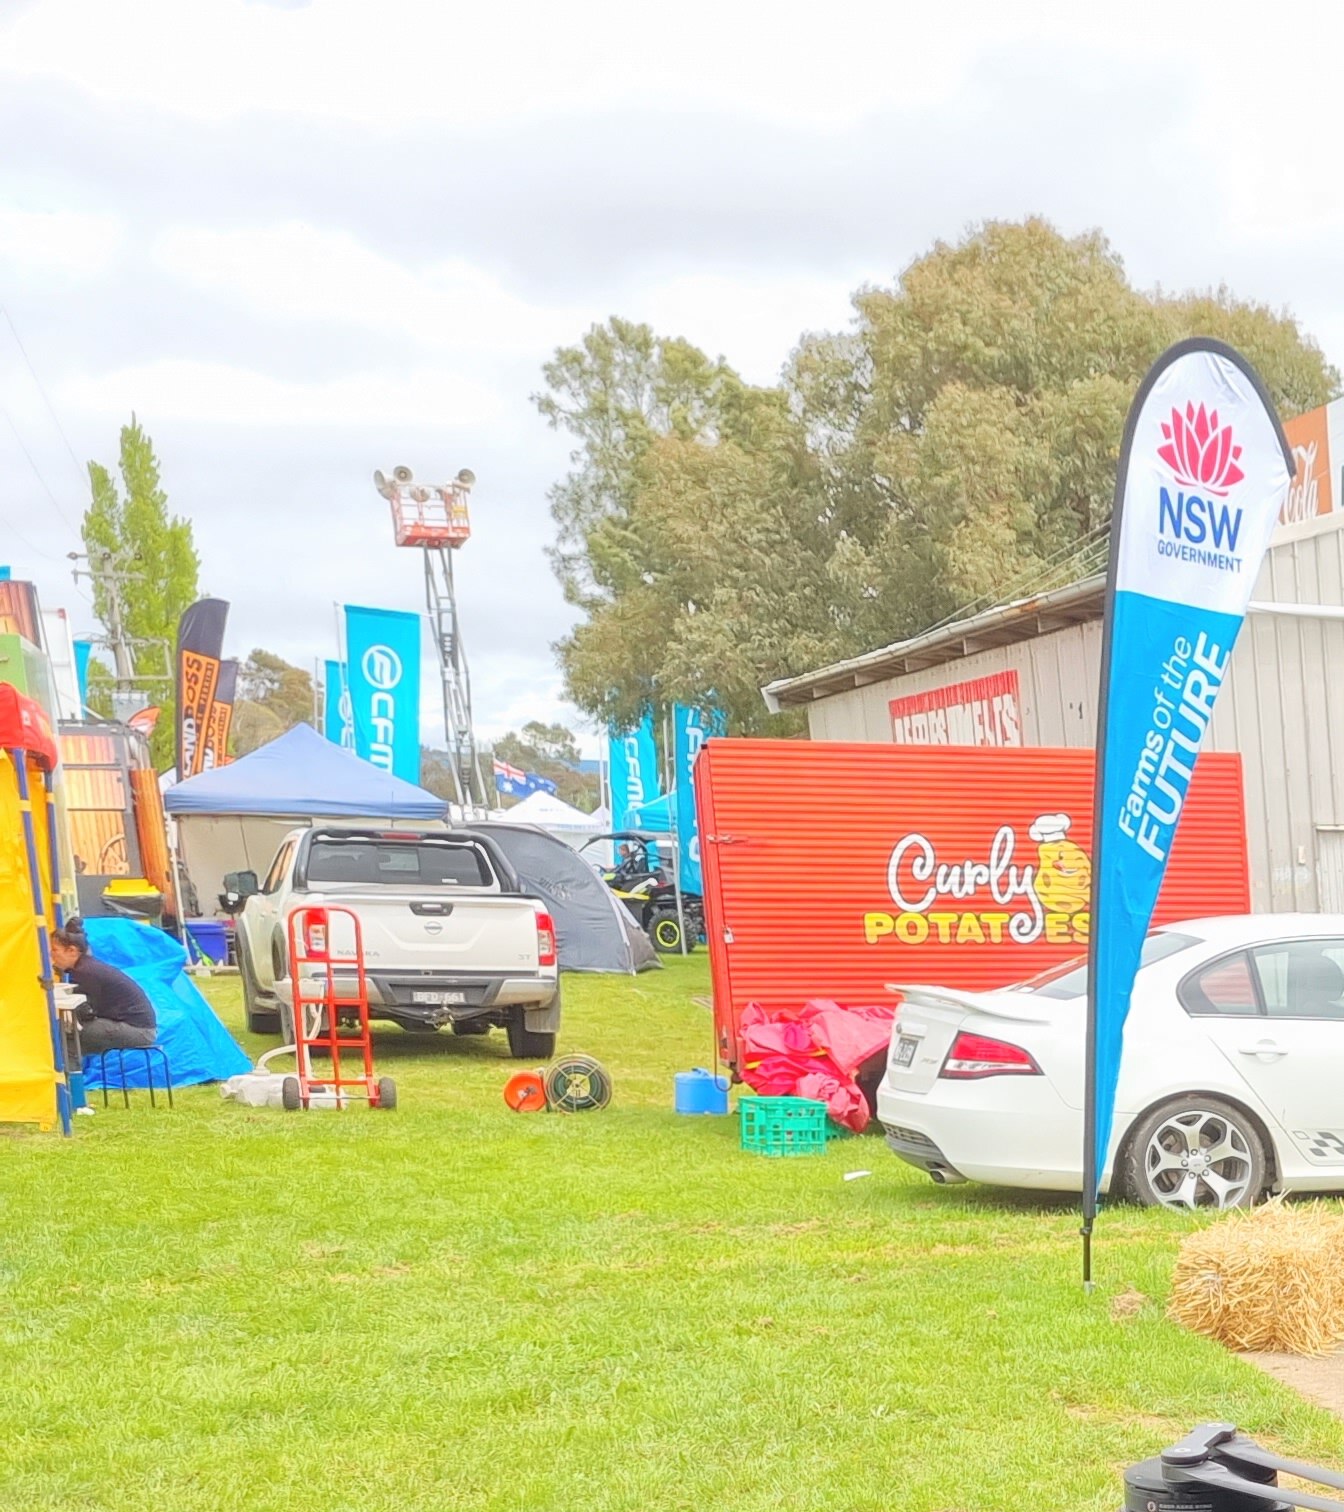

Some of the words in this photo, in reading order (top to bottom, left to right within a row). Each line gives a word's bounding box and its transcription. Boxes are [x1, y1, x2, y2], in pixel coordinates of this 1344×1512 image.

[1158, 486, 1244, 553] NSW
[1157, 539, 1242, 575] GOVERNMENT
[1160, 635, 1193, 692] the
[1153, 682, 1176, 730] of
[1136, 631, 1233, 863] FUTURE
[1118, 732, 1165, 840] Farms
[887, 825, 1040, 916] Curly
[864, 911, 1092, 944] POTATOES
